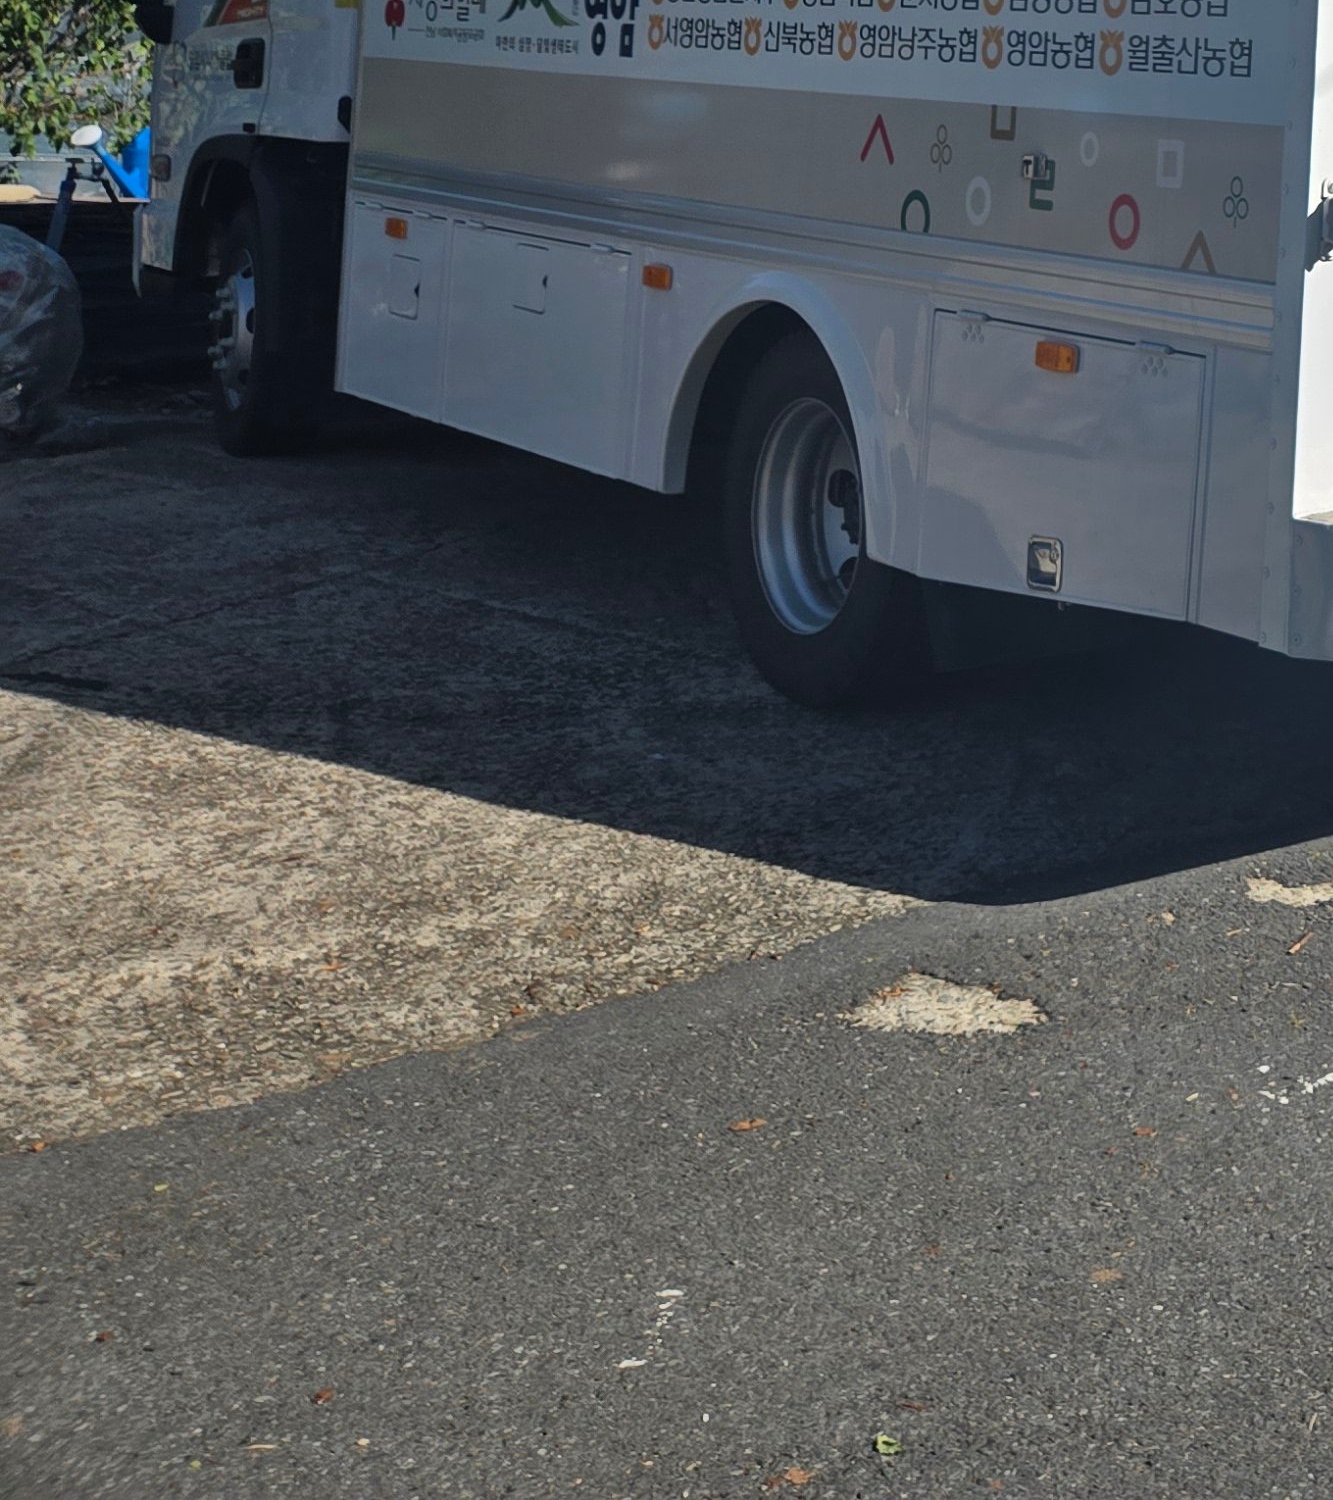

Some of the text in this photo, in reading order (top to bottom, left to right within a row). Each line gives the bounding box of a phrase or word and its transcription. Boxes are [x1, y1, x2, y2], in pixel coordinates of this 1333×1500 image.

[664, 18, 1252, 77] 서영암농협 신북농협 영암낭주농협 영암농협 월출산농협
